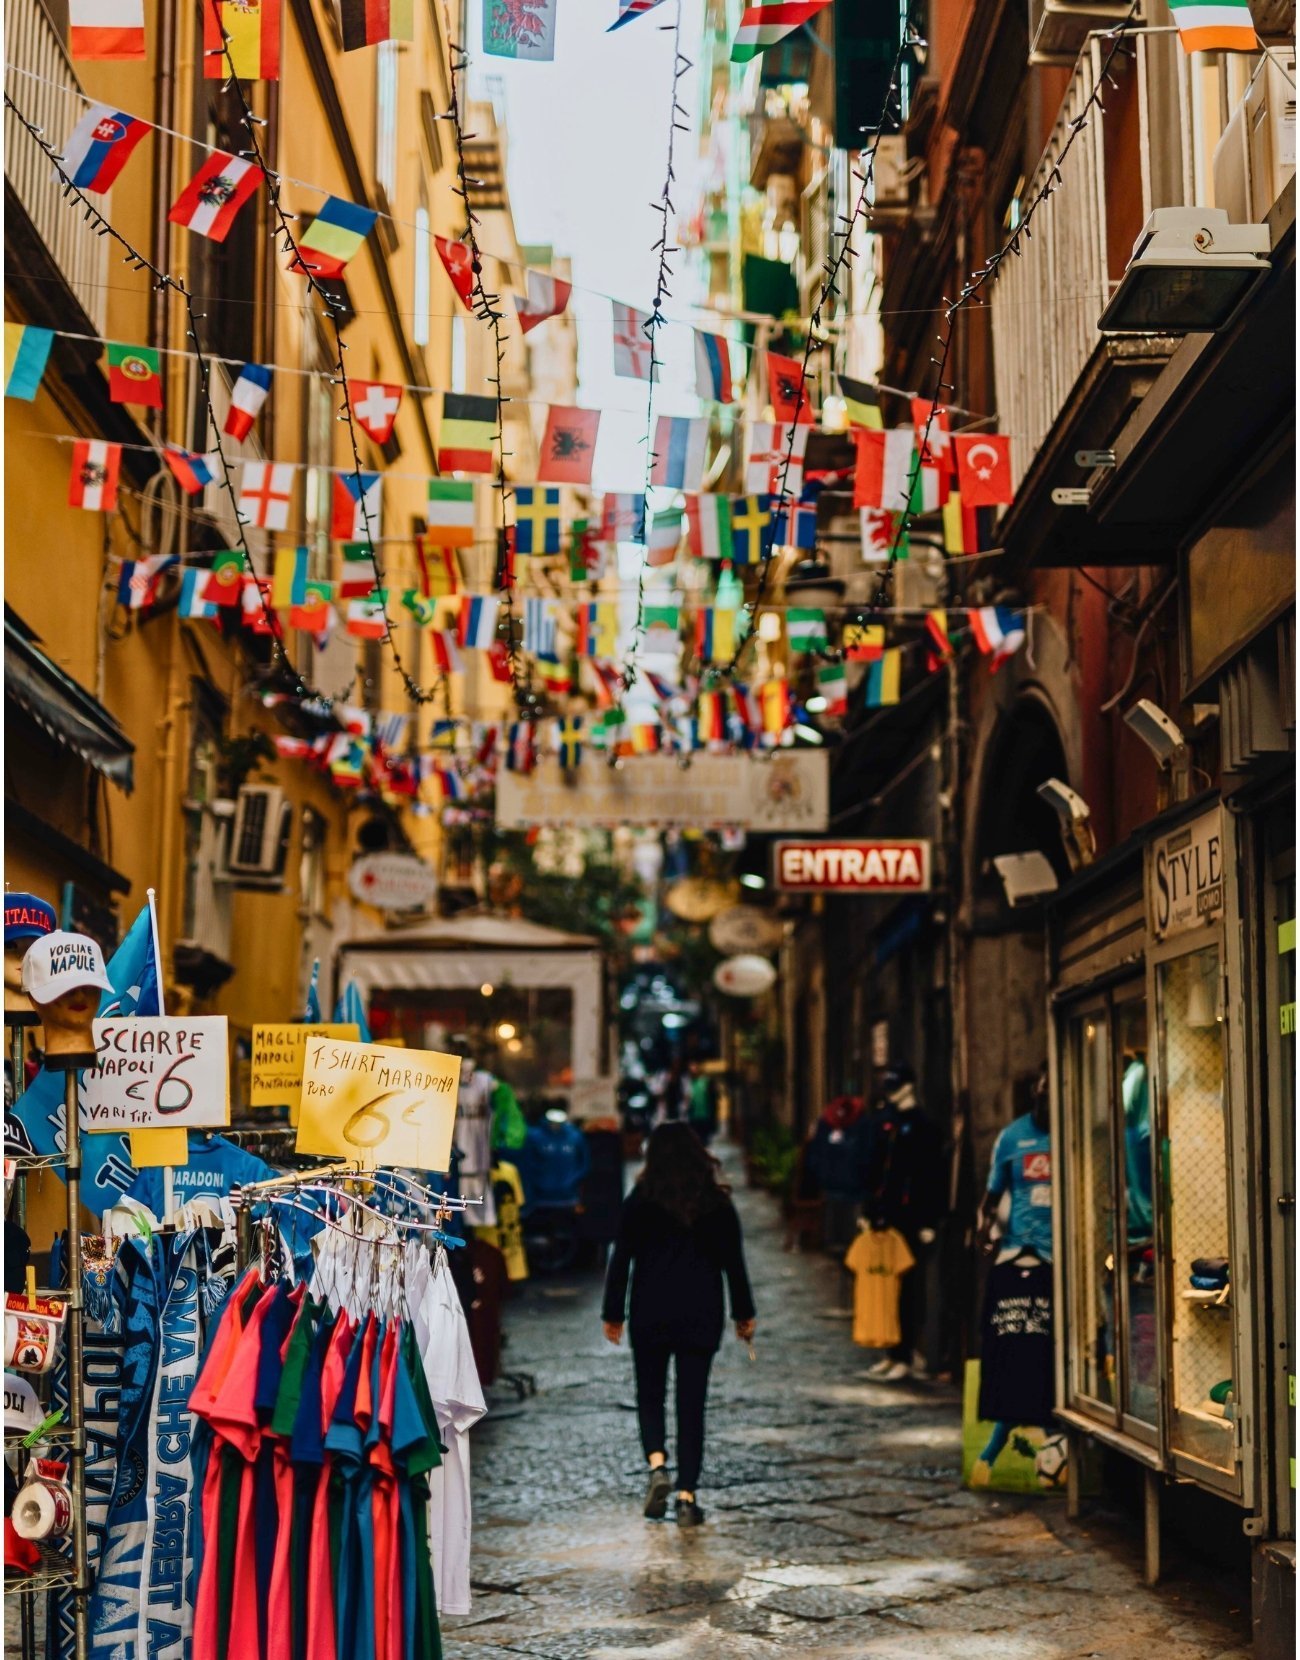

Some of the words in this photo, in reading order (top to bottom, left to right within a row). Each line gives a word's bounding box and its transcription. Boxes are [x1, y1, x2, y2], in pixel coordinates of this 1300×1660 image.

[783, 849, 921, 883] ENTRATA
[1157, 836, 1221, 931] STYLE
[5, 908, 51, 931] ITALIA
[50, 955, 95, 976] NAPULE
[96, 1024, 204, 1055] SCIARPE
[91, 1056, 153, 1079] NAPOLI
[312, 1045, 385, 1073] T-SHIRT
[378, 1066, 454, 1093] MARADONA
[306, 1080, 335, 1097] PURO
[90, 1103, 126, 1120] VARI
